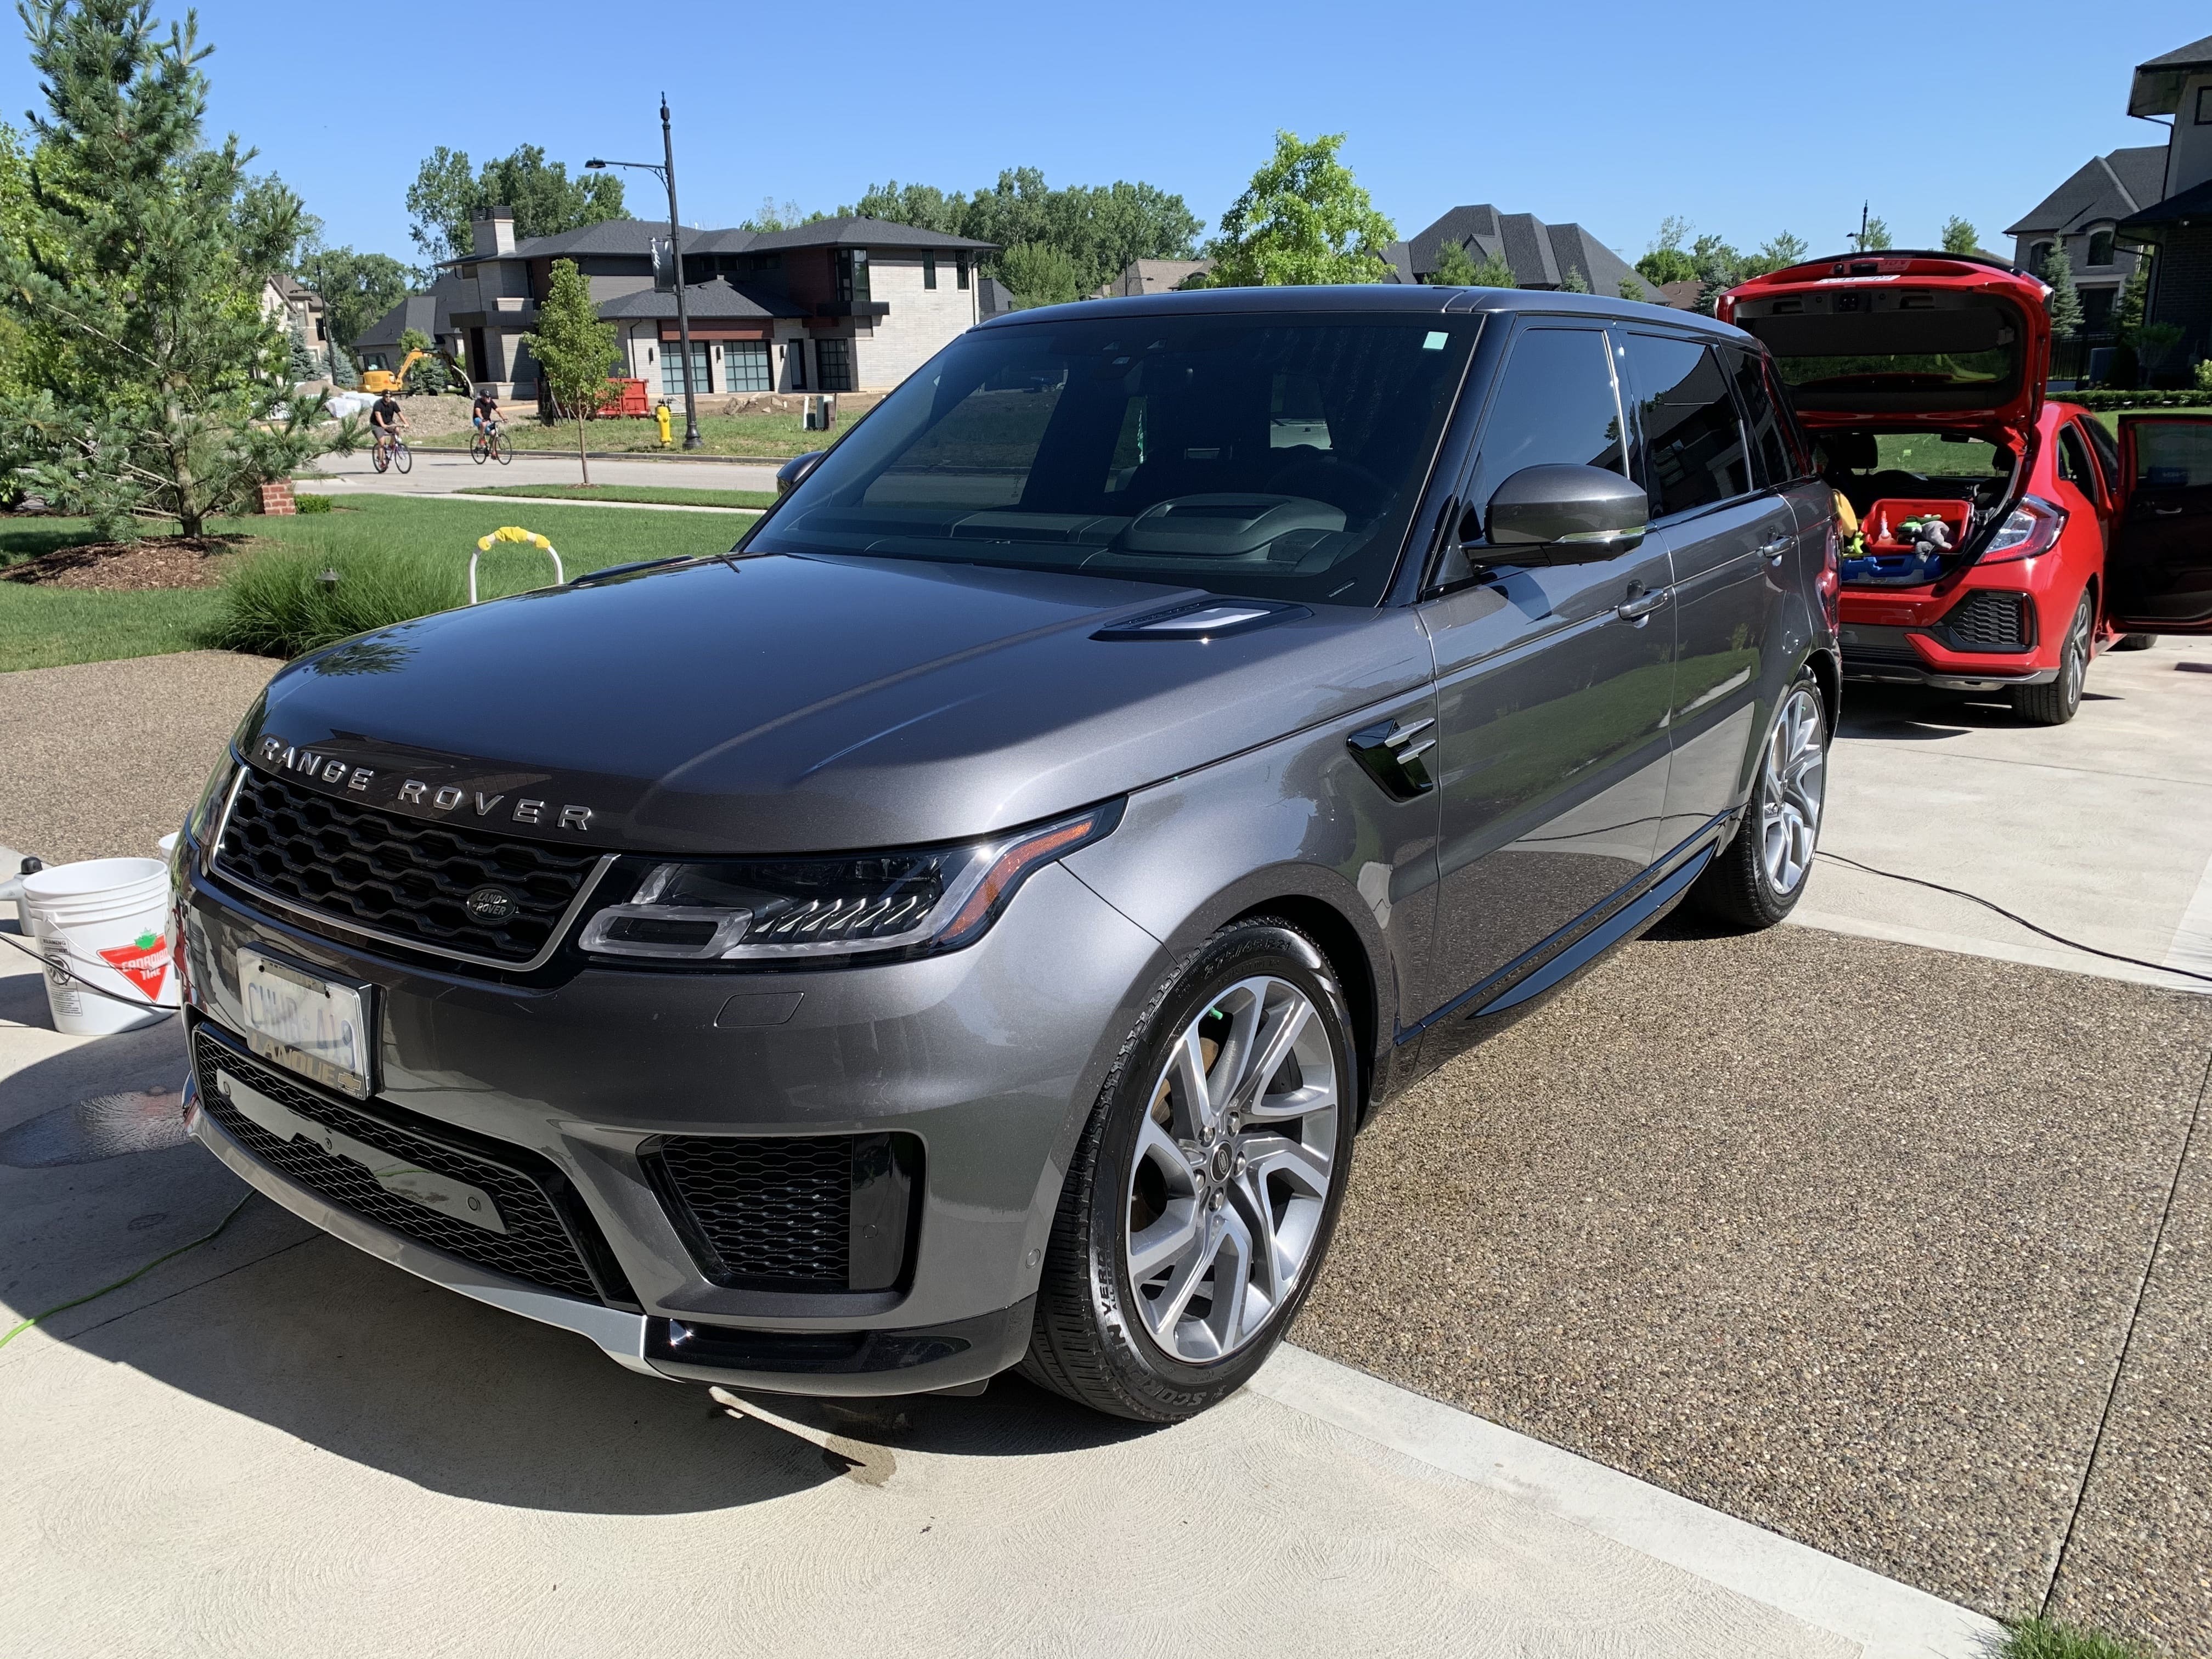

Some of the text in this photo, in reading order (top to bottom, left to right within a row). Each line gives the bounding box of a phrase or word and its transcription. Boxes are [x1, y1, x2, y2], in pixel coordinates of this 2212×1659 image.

[259, 736, 592, 831] RANGE ROVER
[477, 892, 502, 904] LAND
[476, 902, 506, 915] ROVER
[121, 948, 168, 972] CANADIAN
[139, 968, 161, 980] TIRE
[1106, 1324, 1207, 1407] SCORPION
